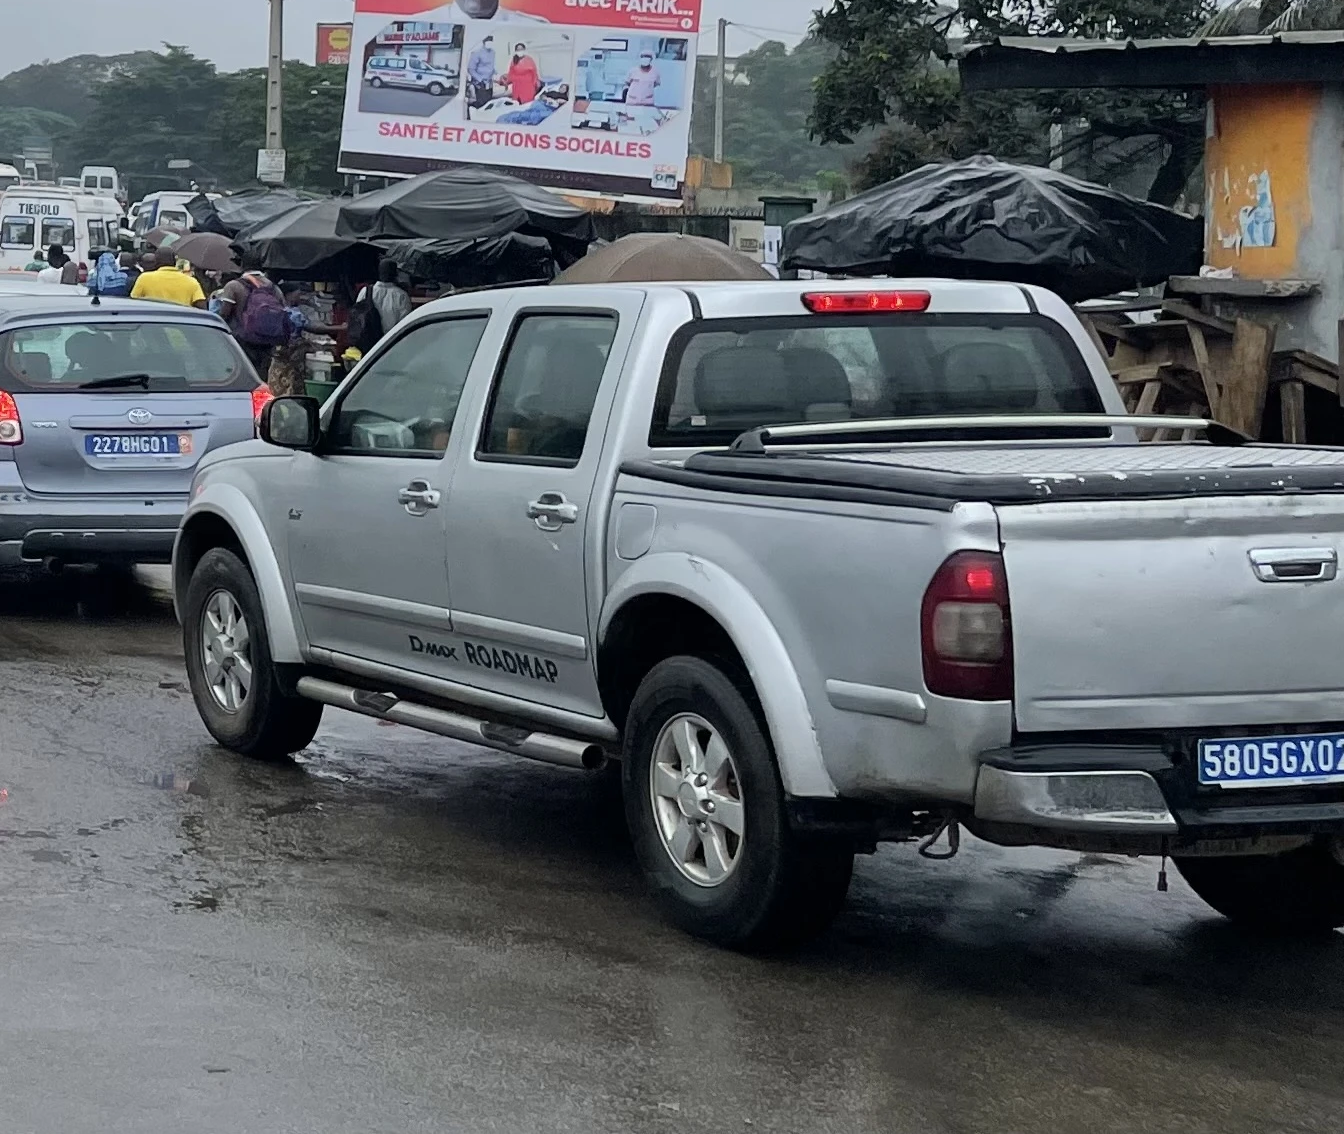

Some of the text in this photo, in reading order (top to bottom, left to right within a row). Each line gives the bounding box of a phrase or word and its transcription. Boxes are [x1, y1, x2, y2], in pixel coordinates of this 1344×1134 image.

[378, 121, 651, 159] SANTÉ ET ACTIONS SOCIALES
[92, 436, 169, 453] 2278HG01
[464, 641, 558, 683] ROADMAP
